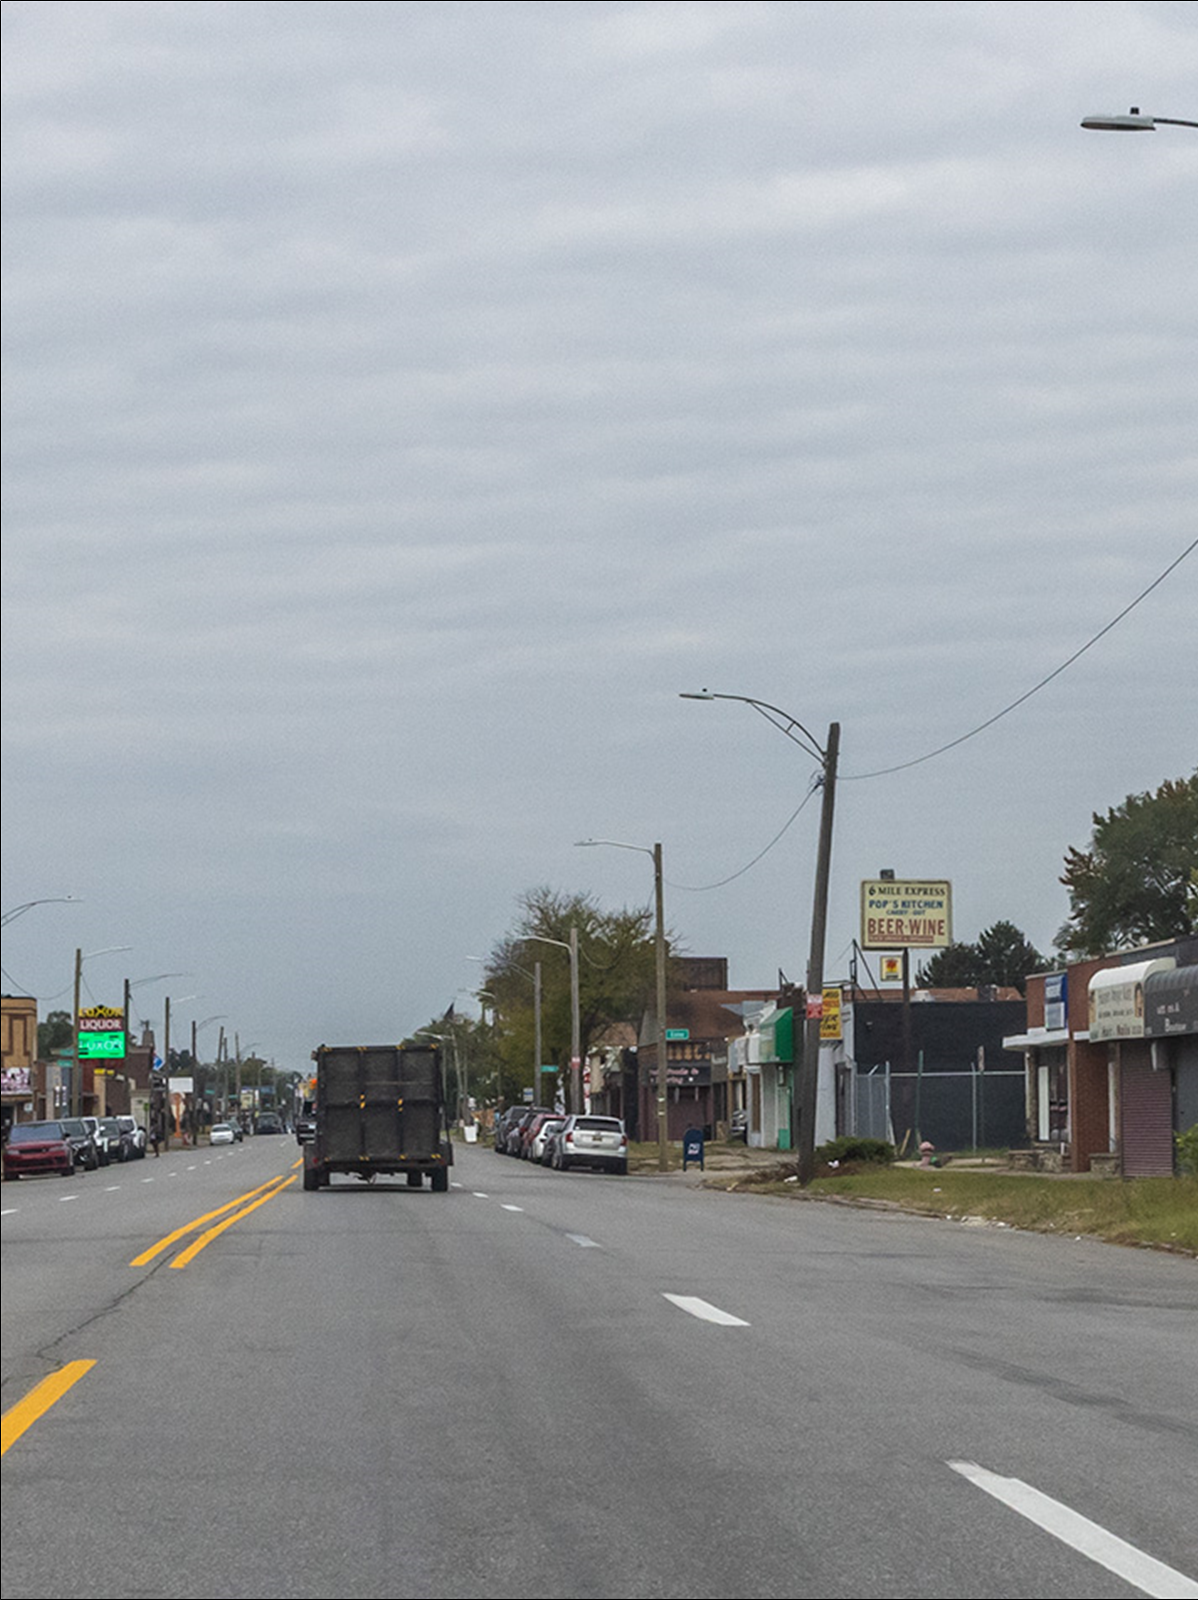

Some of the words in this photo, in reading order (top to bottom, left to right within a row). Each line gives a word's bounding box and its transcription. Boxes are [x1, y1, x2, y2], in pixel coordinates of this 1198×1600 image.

[868, 885, 876, 896] 6
[878, 886, 901, 895] MILE
[905, 886, 945, 896] EXPRESS
[901, 900, 943, 909] KITCHEN
[80, 1019, 122, 1031] LIQUOR
